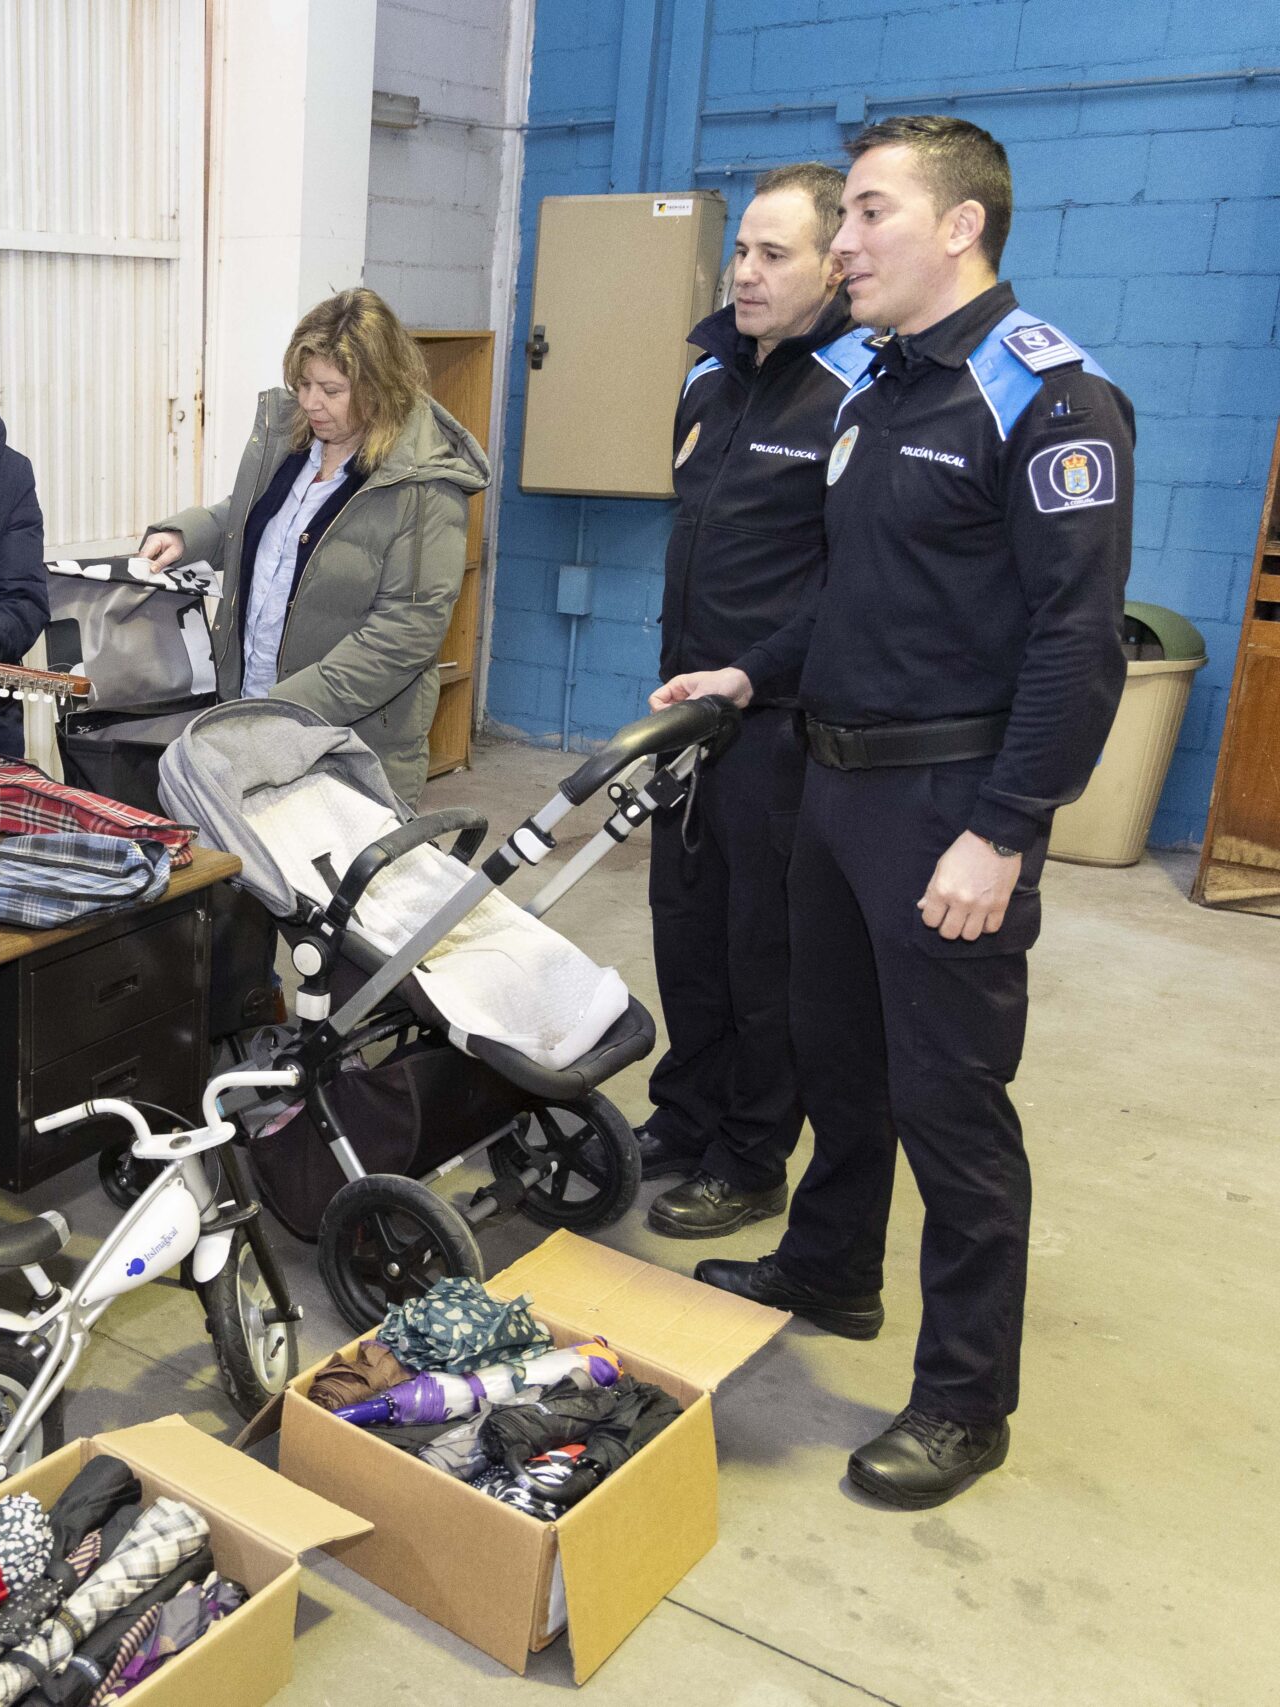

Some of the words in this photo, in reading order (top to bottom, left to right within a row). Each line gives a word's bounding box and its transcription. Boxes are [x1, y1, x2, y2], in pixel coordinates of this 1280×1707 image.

[750, 443, 783, 456] POLICÍA
[789, 449, 817, 461] LOCAL
[899, 446, 928, 459] POLICÍA
[934, 452, 965, 468] LOCAL
